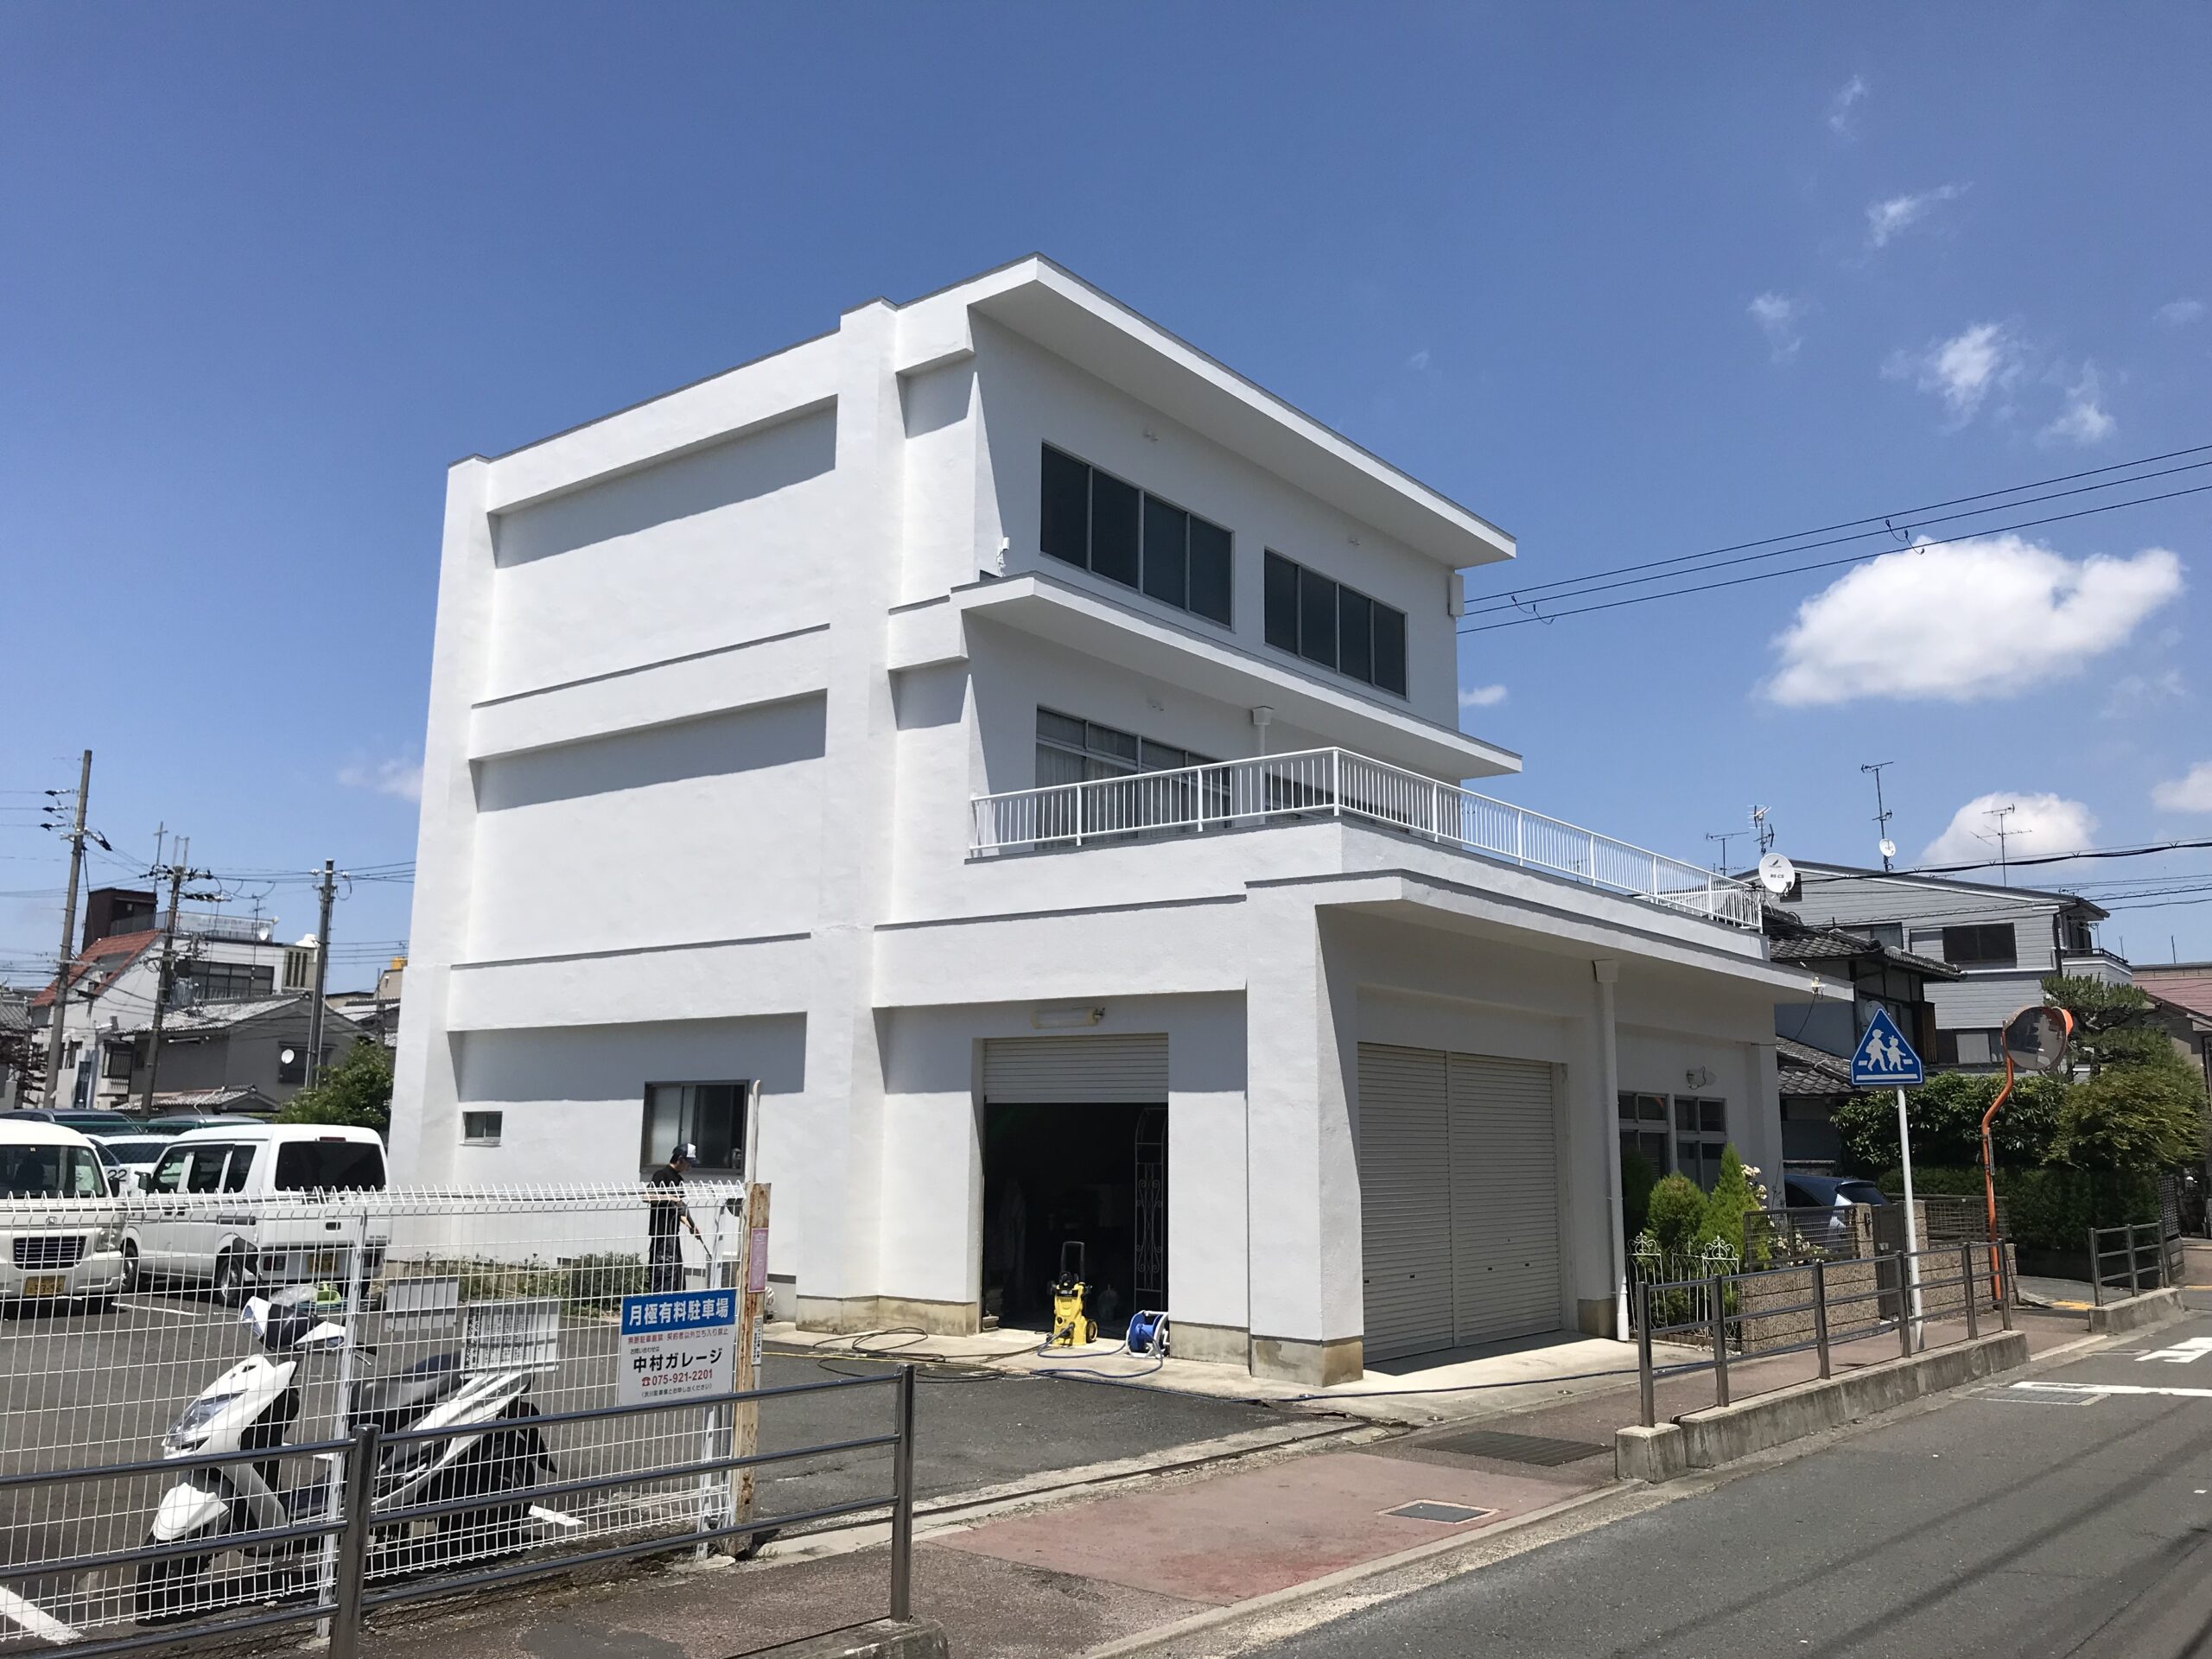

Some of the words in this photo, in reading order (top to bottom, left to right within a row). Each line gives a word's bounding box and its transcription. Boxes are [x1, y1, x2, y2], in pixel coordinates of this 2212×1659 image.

[107, 1169, 128, 1182] 22
[629, 1298, 728, 1326] 月極有料駐車場
[633, 1348, 722, 1373] 中村ガレージ
[652, 1369, 713, 1385] 075-921-2201
